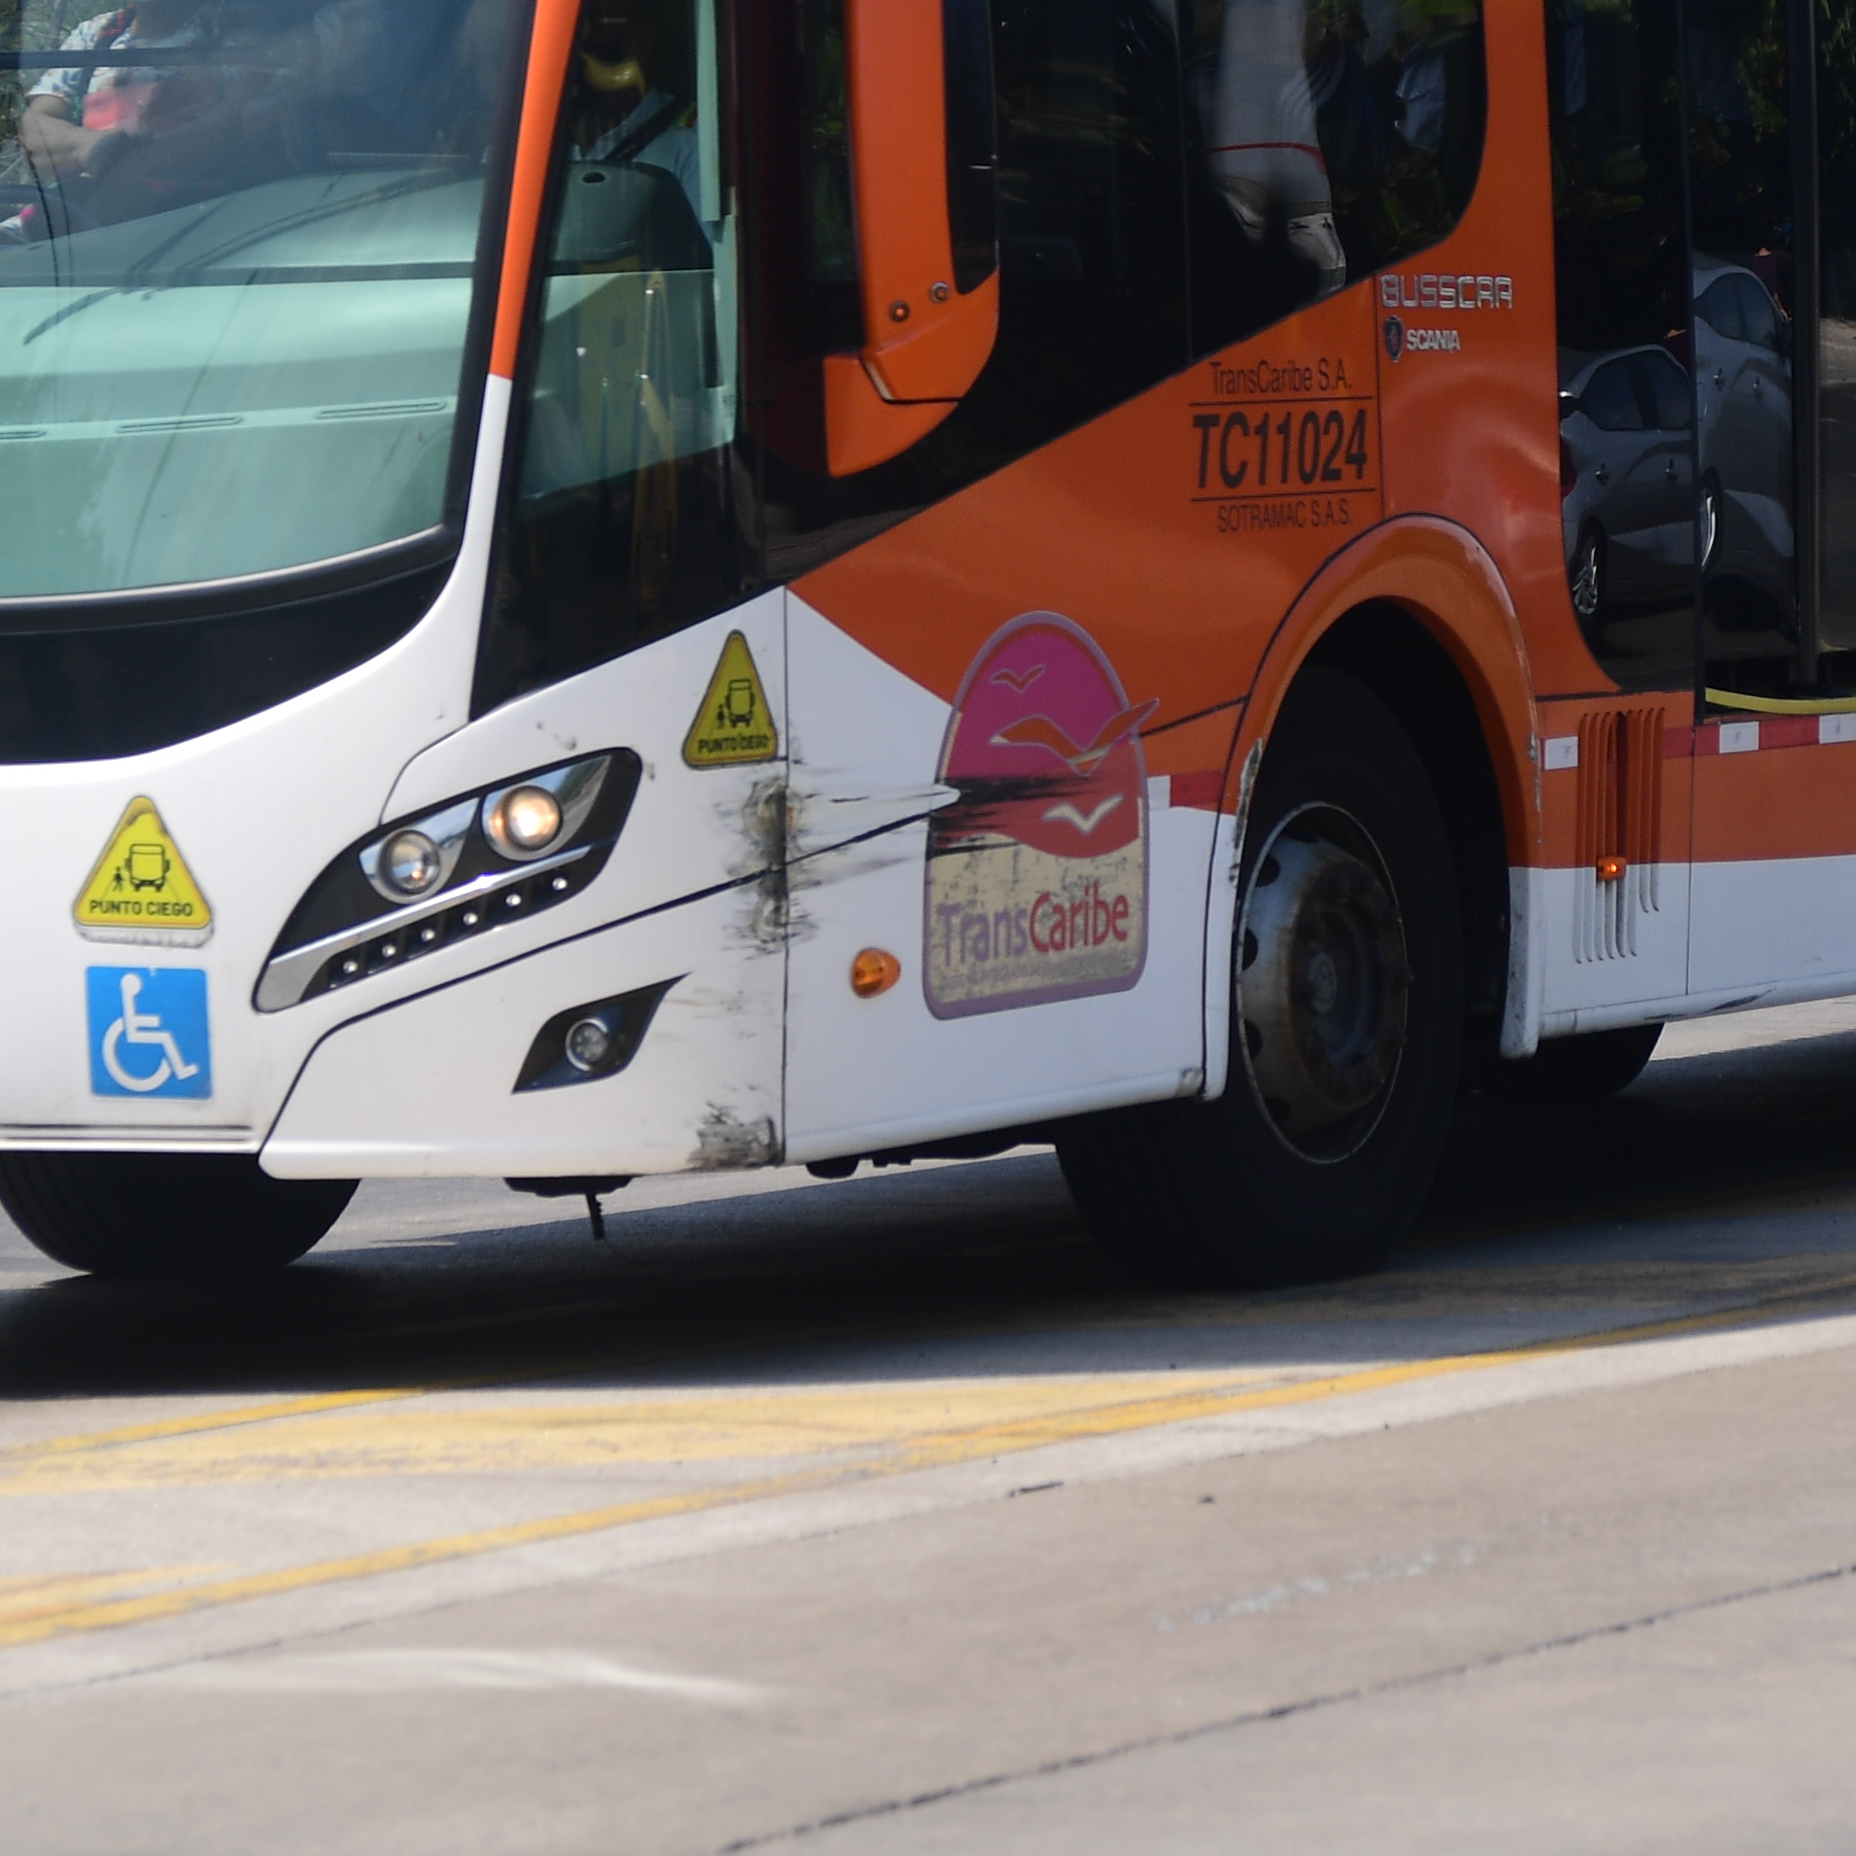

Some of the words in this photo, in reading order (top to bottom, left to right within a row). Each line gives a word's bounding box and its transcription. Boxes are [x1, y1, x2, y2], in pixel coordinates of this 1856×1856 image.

[1381, 274, 1513, 310] BUSSCAR
[1406, 328, 1461, 353] SCANIA
[1209, 358, 1313, 397] TransCaribe
[1318, 357, 1353, 391] S.A.
[1192, 407, 1368, 490] TC11024
[1217, 501, 1307, 533] SOTRAMAC
[89, 900, 143, 916] PUNTO
[145, 901, 194, 918] CIEGO
[937, 883, 1129, 969] TransCaribe
